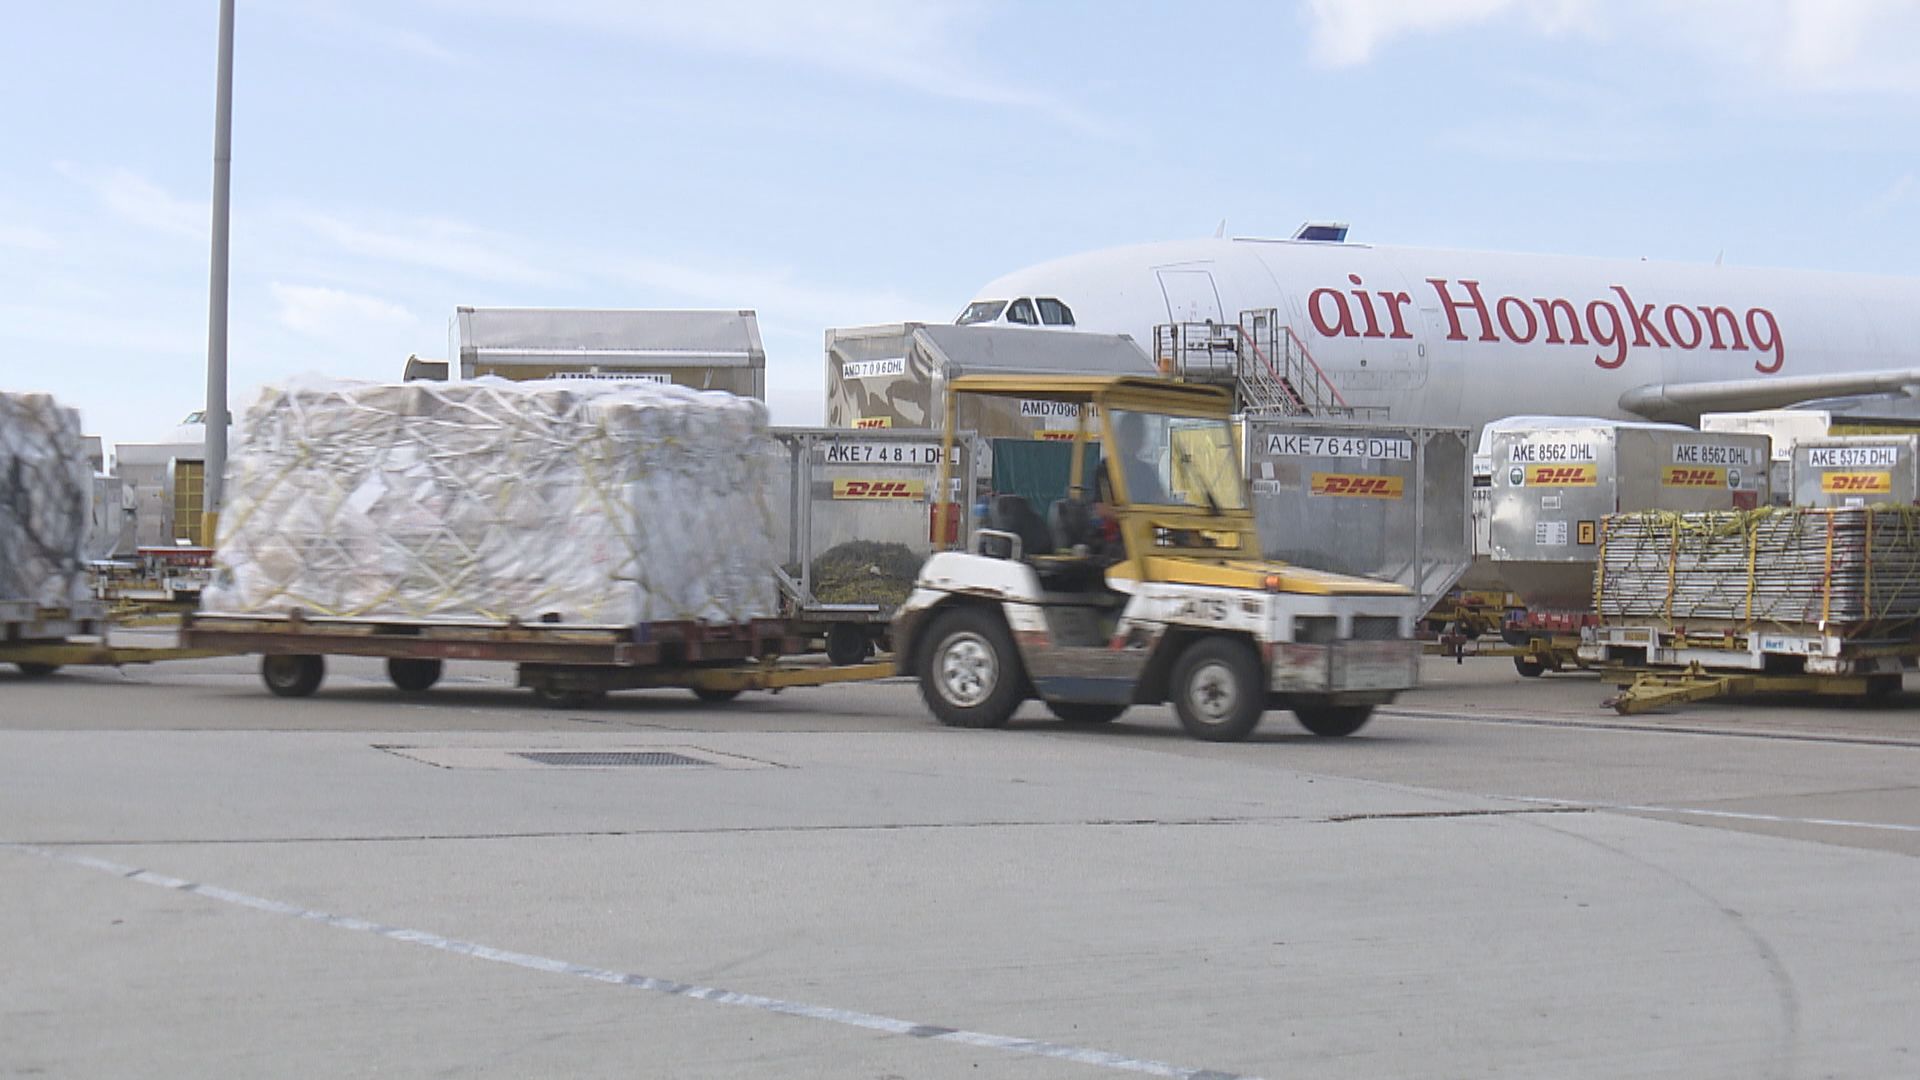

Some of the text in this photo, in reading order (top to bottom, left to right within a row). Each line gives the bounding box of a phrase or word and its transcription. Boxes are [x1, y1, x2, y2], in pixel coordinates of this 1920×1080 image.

[1308, 274, 1785, 373] air Hongkong
[1512, 444, 1593, 462] AKE 8562 DHL
[1676, 445, 1749, 464] AKE 8562 DHL
[1810, 449, 1895, 465] AKE 5375 DHL
[1535, 468, 1586, 484] DHL
[1671, 469, 1718, 485] DHL
[1831, 476, 1881, 489] DHL
[846, 481, 911, 498] DHL
[1324, 477, 1392, 495] DHL
[1582, 526, 1590, 541] F
